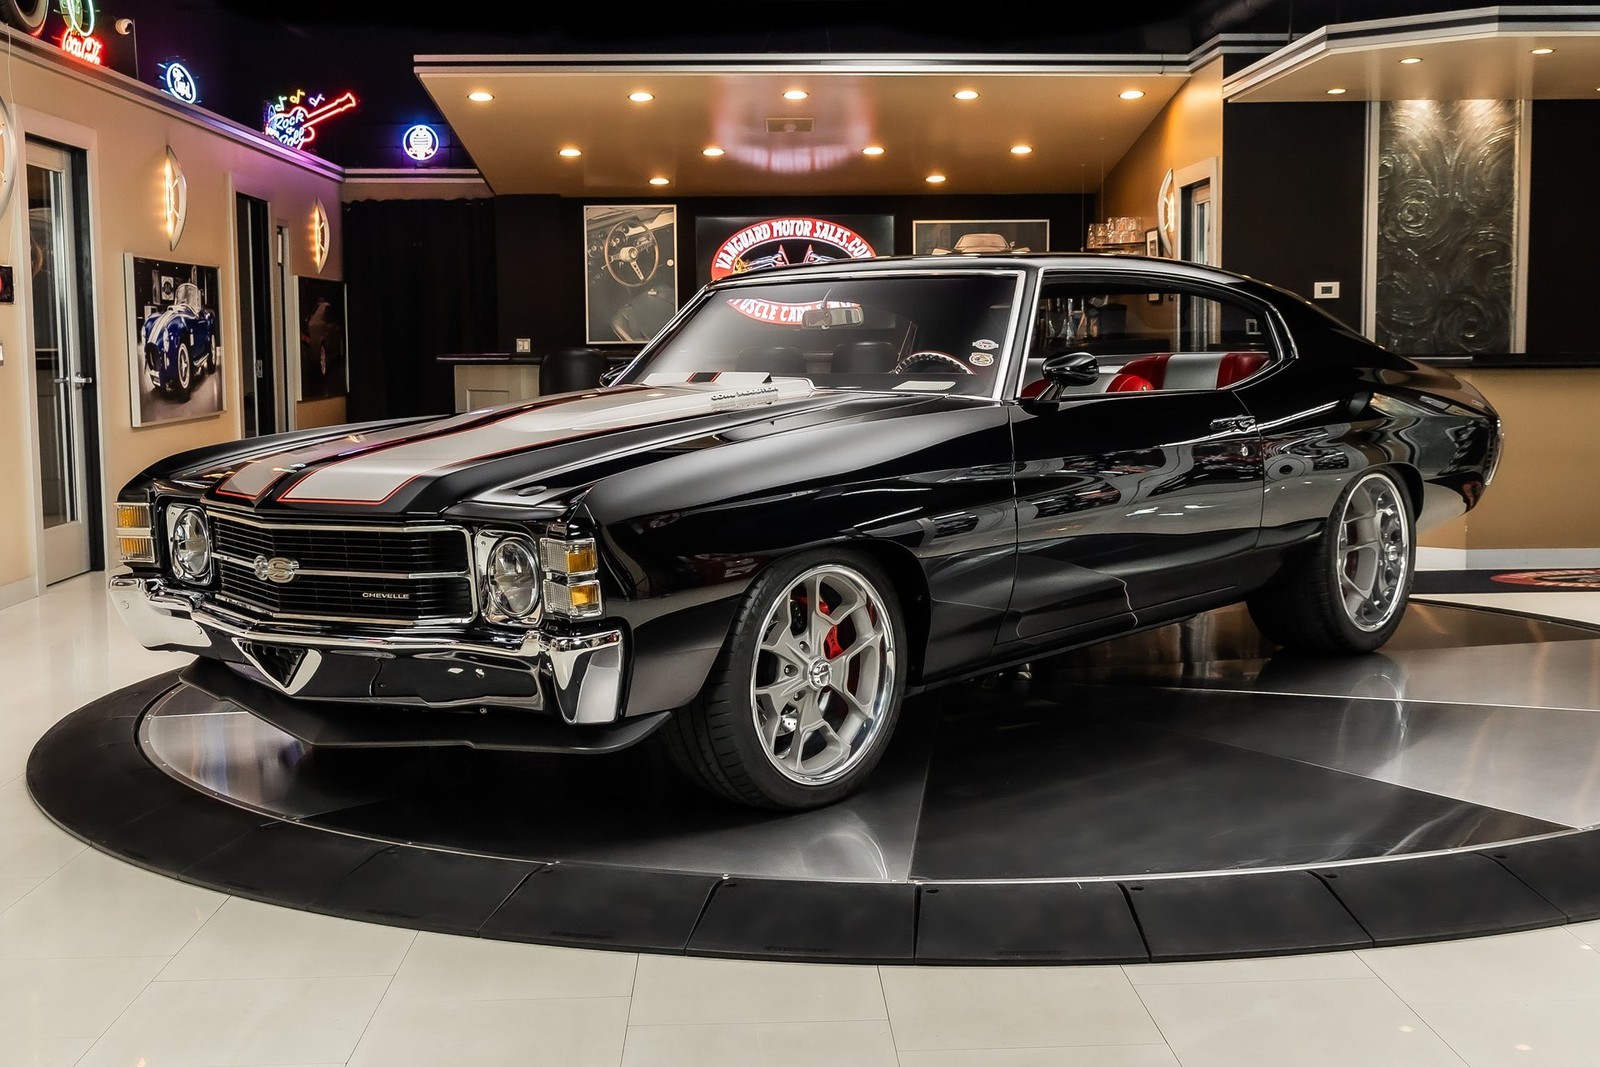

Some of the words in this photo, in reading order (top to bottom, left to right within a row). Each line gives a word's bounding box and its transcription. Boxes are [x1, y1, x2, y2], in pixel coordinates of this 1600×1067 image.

[272, 109, 305, 131] Rock
[715, 223, 771, 270] VANGUARD
[771, 218, 813, 238] MOTOR
[780, 304, 812, 322] CAR
[362, 592, 410, 600] CHEVELLE
